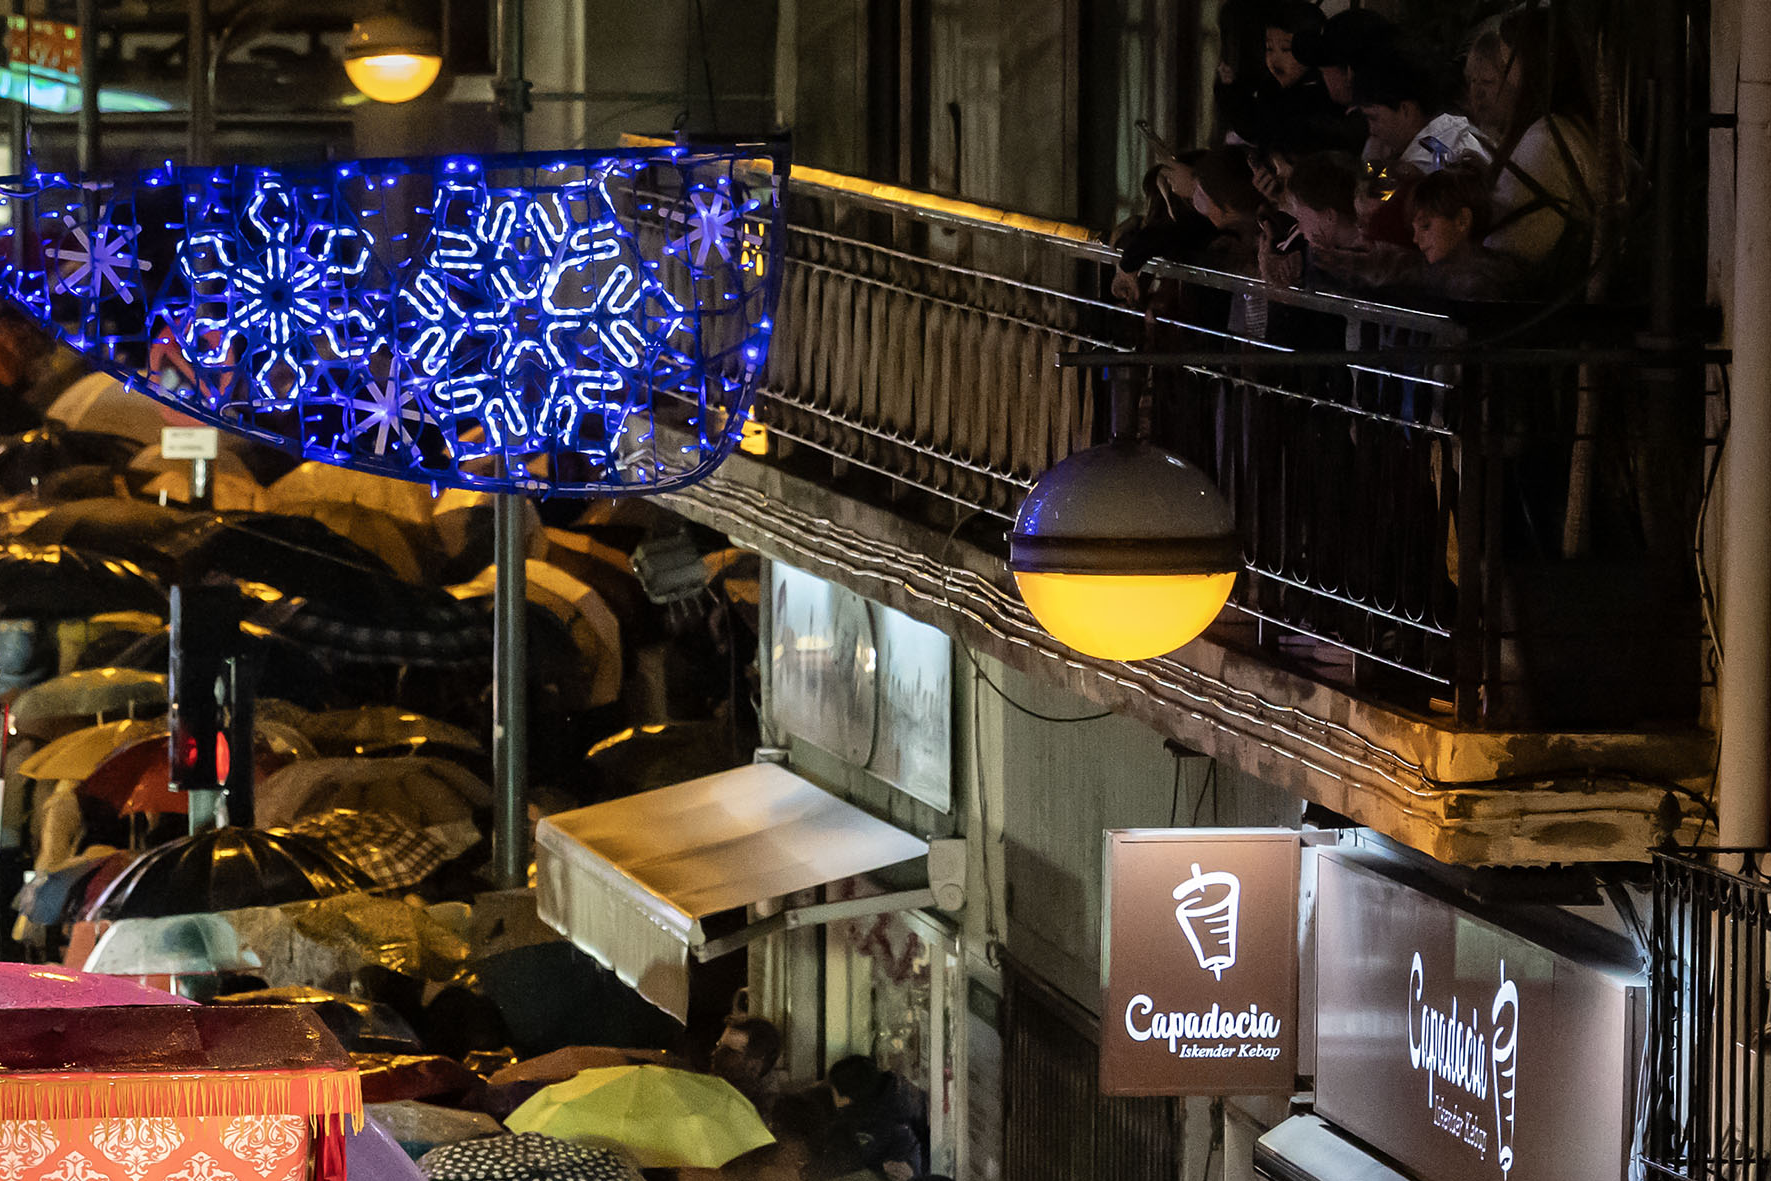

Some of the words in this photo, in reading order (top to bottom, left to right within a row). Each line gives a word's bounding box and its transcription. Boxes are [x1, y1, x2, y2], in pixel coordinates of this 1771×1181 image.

[1125, 994, 1281, 1053] Capadocia
[1179, 1043, 1236, 1058] Iskender
[1237, 1043, 1281, 1061] Kebap
[1409, 951, 1488, 1109] Capadocia
